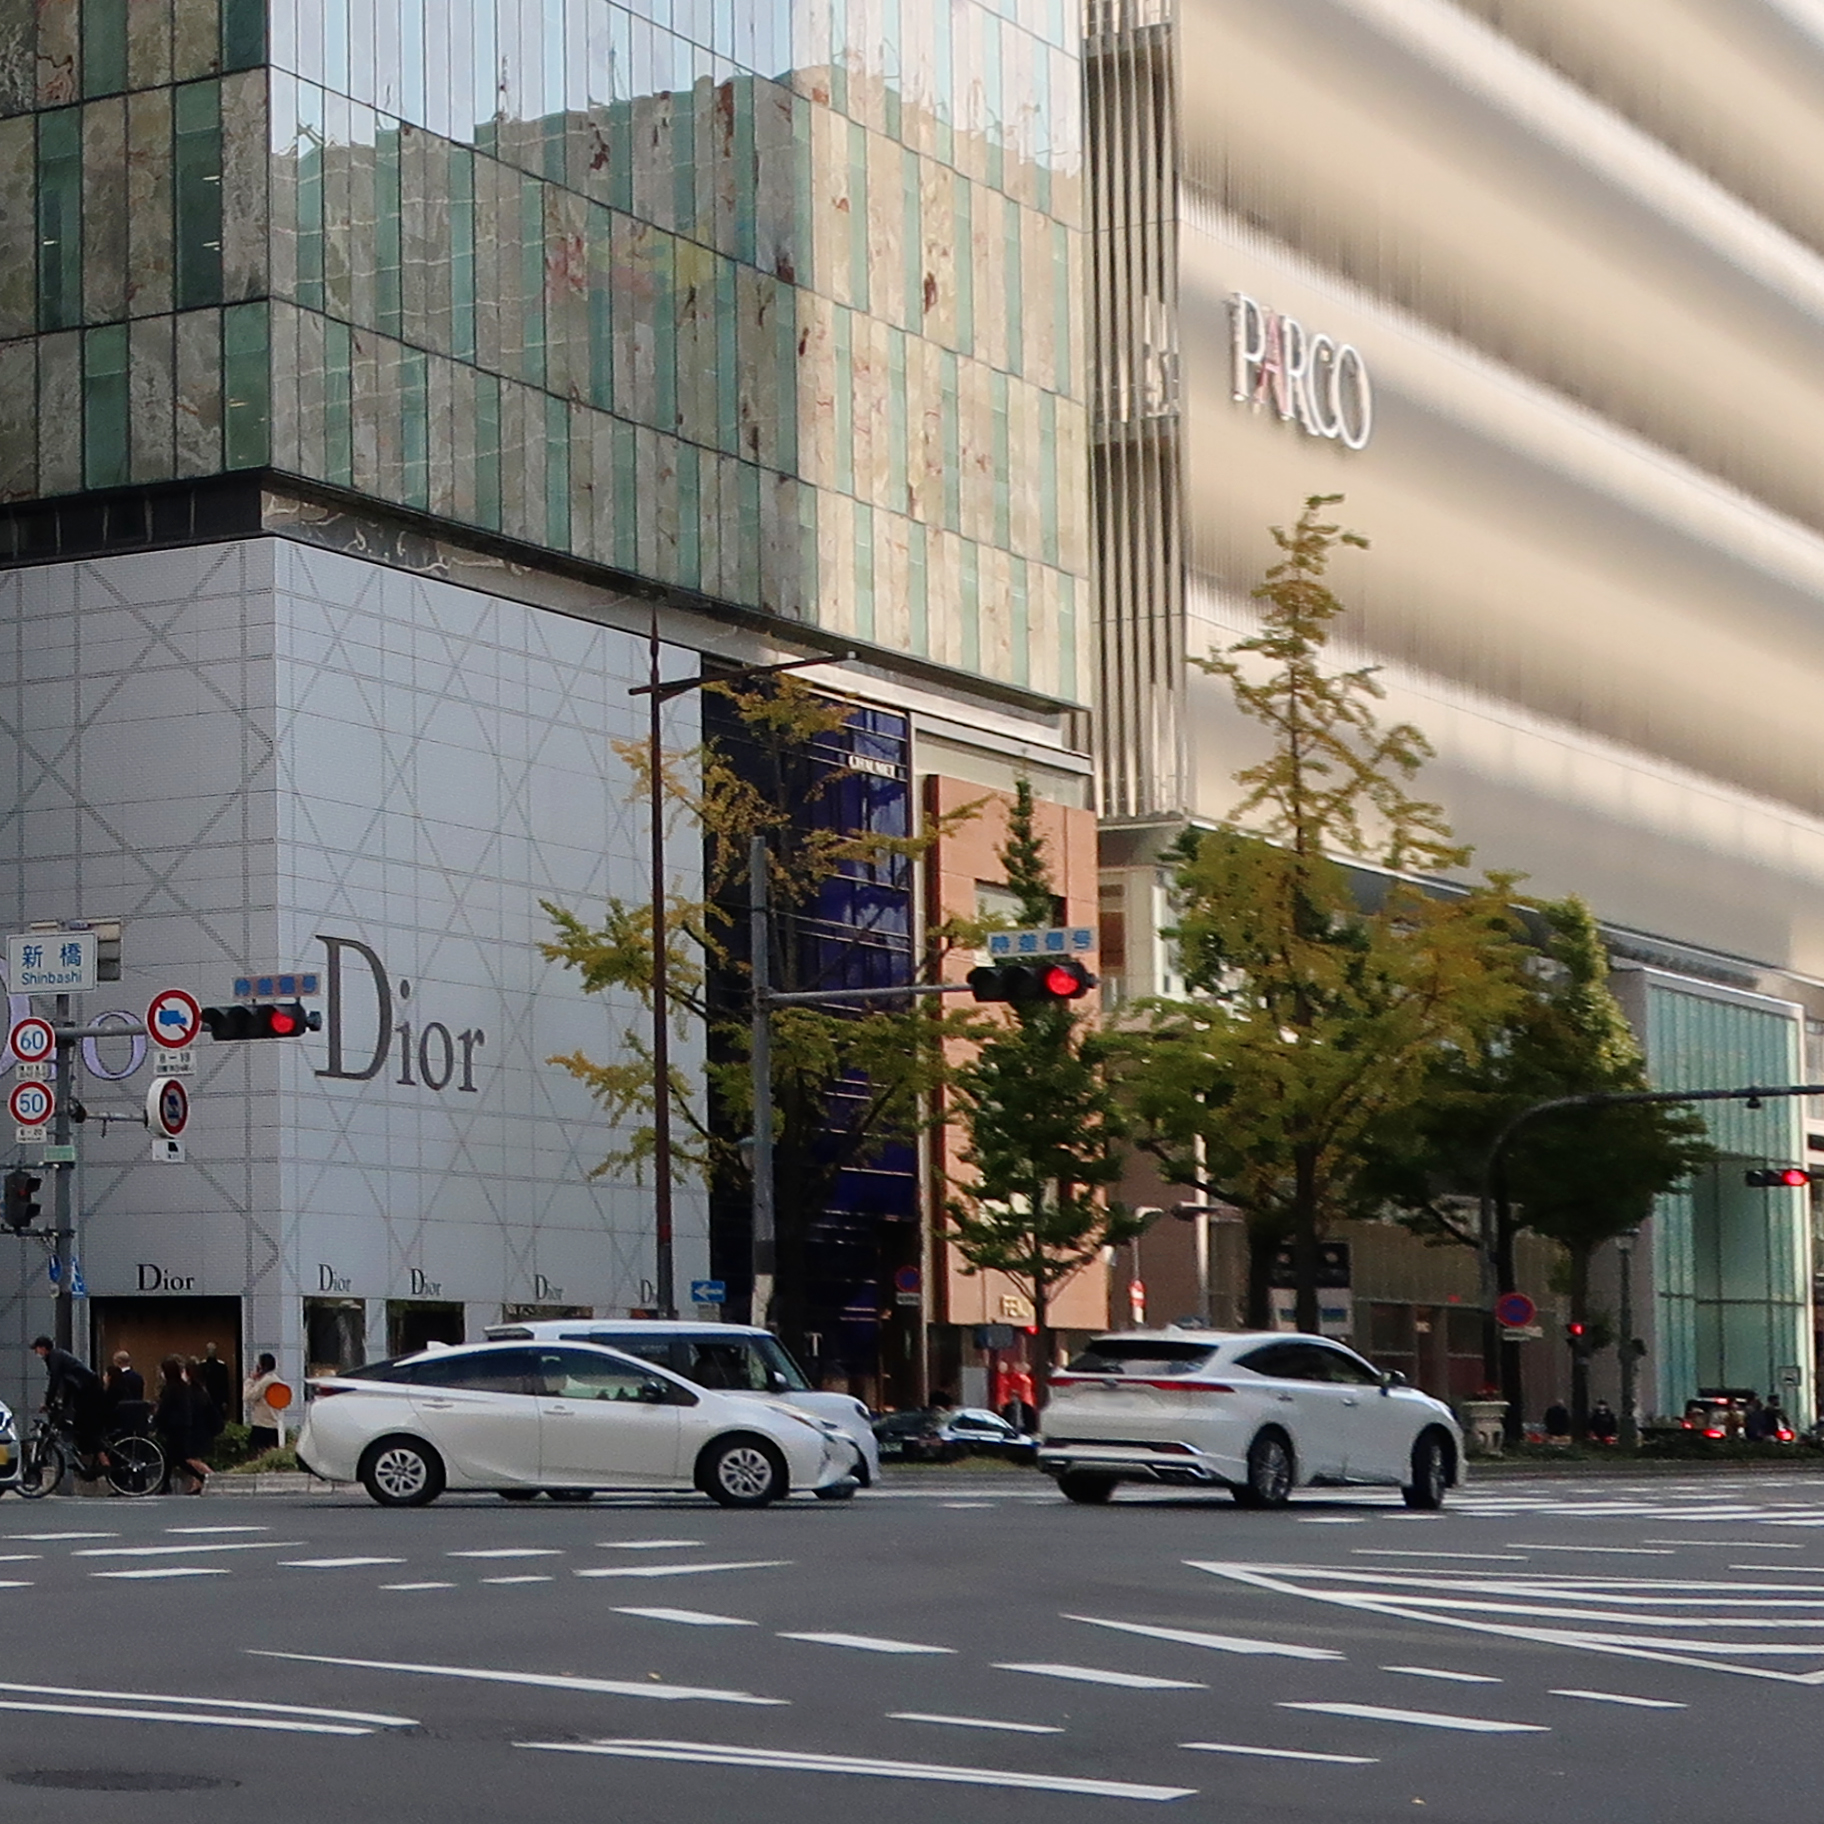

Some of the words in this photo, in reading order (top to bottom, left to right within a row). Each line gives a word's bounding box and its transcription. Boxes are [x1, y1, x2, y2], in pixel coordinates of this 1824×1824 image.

[1228, 290, 1375, 451] PARCO
[21, 942, 83, 969] 新橋
[20, 970, 83, 986] Shinbashi
[314, 934, 486, 1092] Dior
[20, 1030, 45, 1051] 60
[18, 1093, 44, 1113] 50
[136, 1263, 195, 1291] Dior
[318, 1263, 352, 1292] Dior
[410, 1268, 442, 1296] Dior
[534, 1274, 564, 1302] Dior
